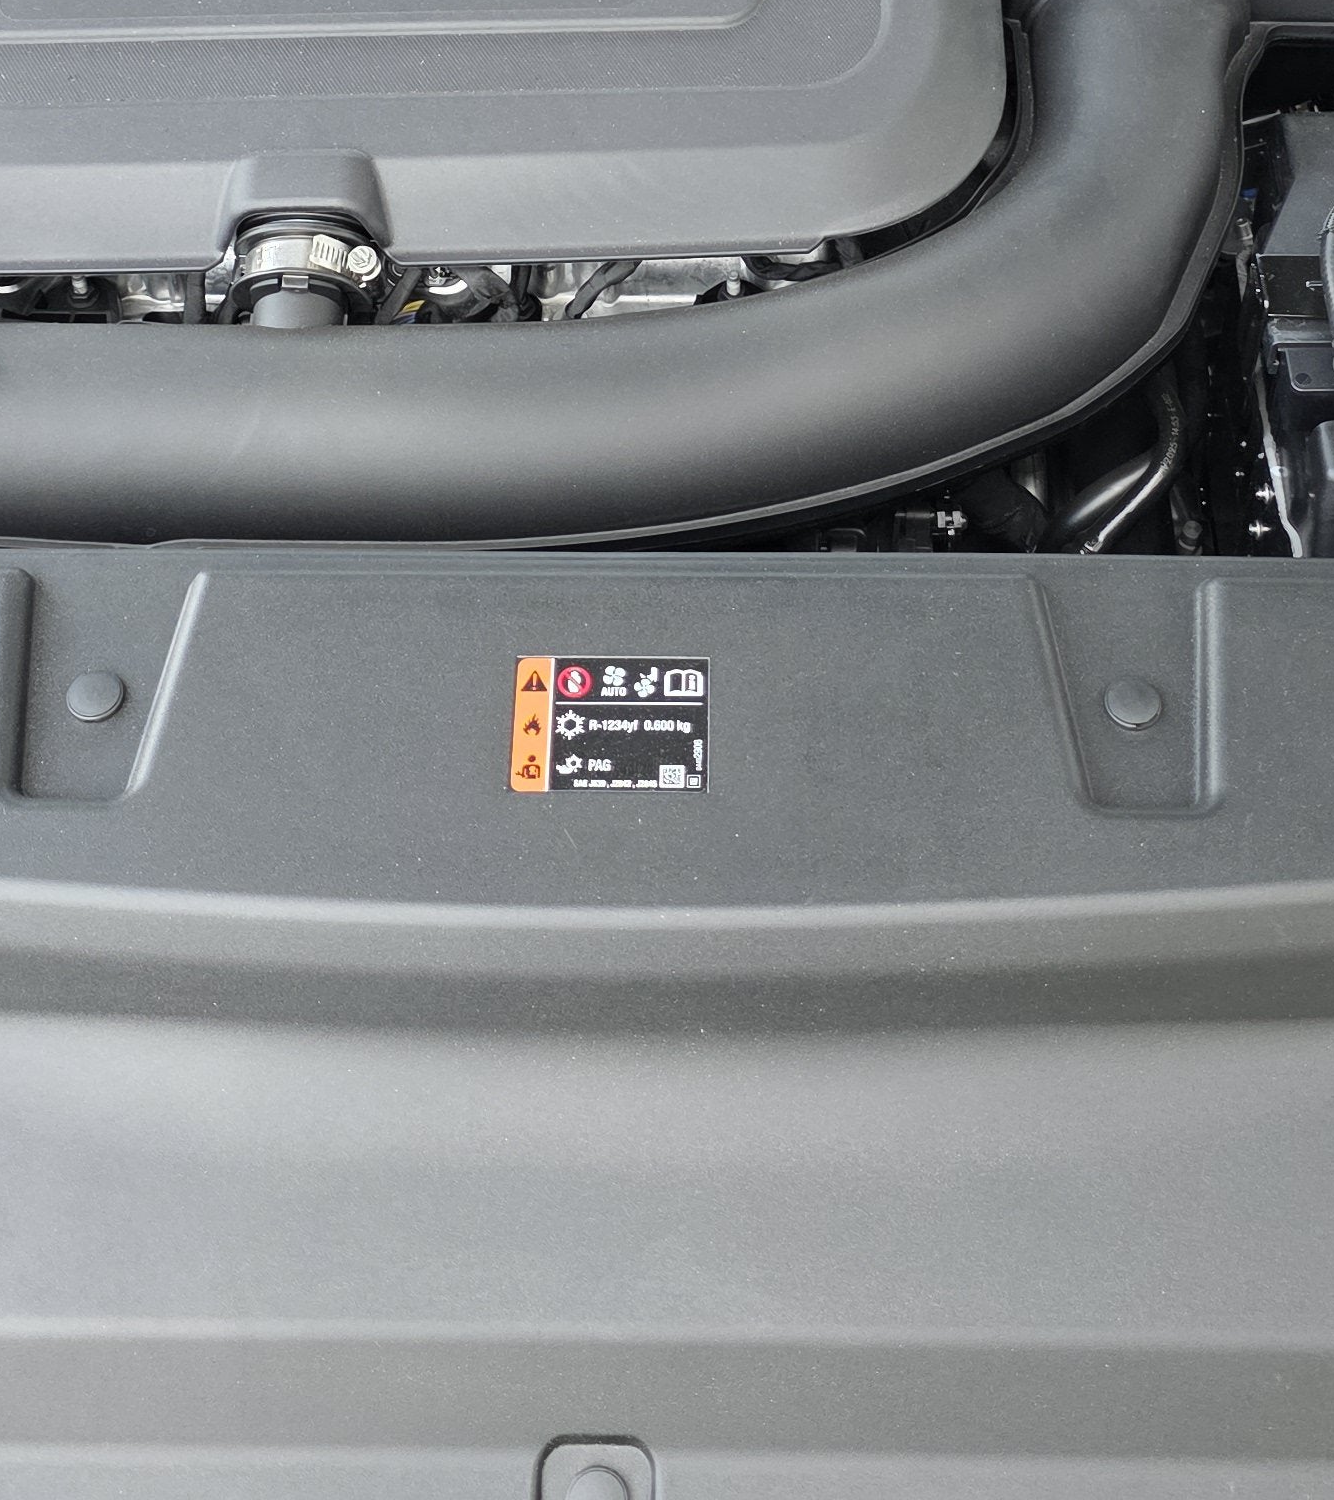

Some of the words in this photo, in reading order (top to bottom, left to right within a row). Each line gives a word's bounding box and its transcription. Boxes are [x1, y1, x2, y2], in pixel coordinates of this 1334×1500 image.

[601, 687, 627, 696] AUTO
[589, 719, 638, 733] R-1234yf
[643, 720, 675, 731] 0.600
[676, 720, 691, 733] kg
[588, 759, 612, 771] PAG
